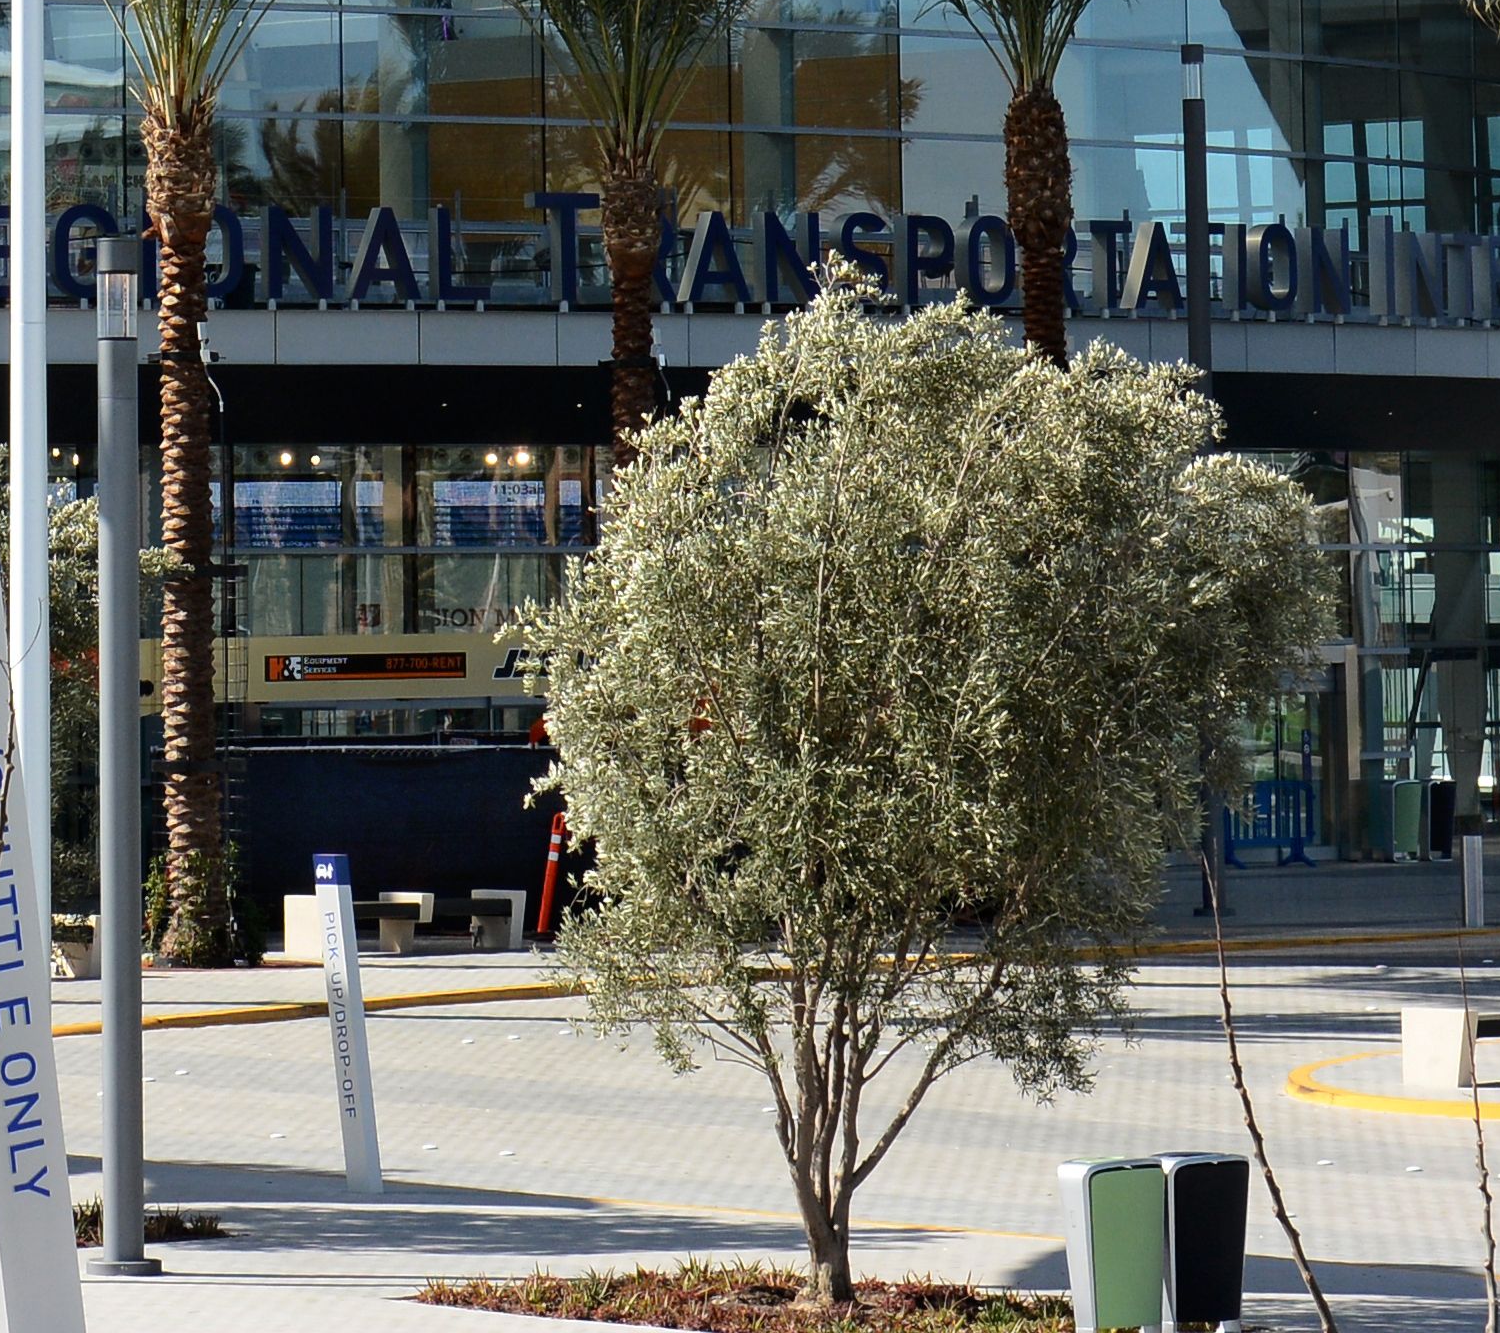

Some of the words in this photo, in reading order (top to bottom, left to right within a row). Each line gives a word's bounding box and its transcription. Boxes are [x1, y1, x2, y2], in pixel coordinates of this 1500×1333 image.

[524, 192, 1350, 315] TANSPOTAION
[385, 655, 463, 671] 877-700-RENT
[324, 911, 357, 1118] PICK-UP/DROP-OFF
[0, 1051, 50, 1198] ONLY
